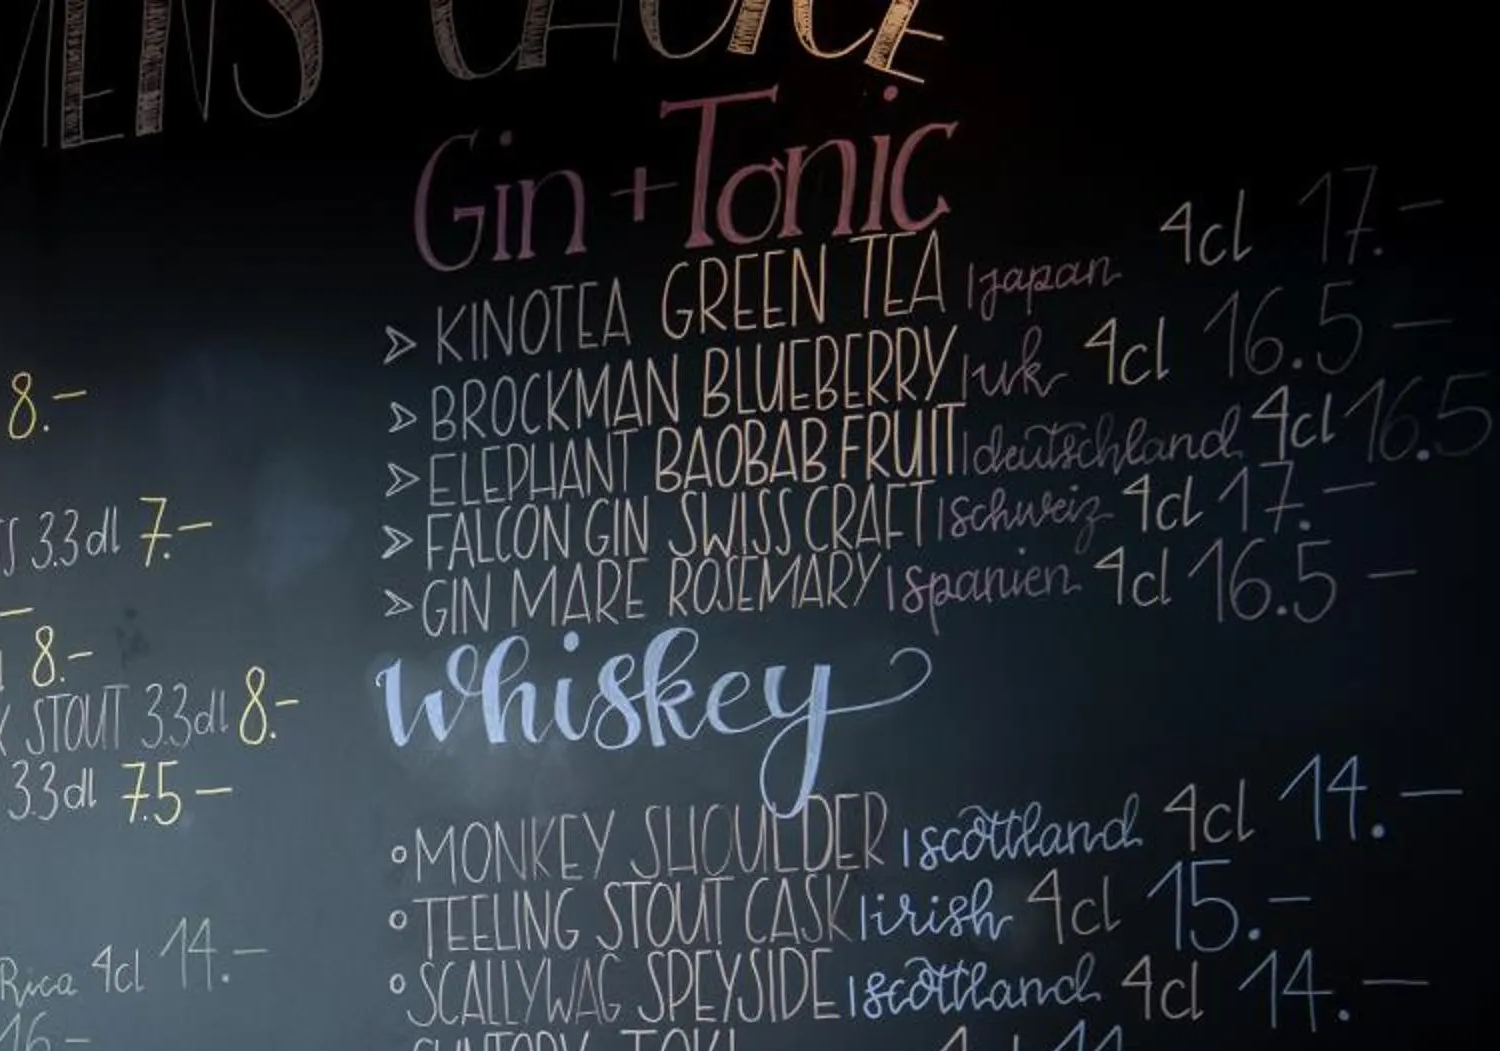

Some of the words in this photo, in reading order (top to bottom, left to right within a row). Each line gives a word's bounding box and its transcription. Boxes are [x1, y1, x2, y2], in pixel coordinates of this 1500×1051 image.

[413, 130, 588, 272] Gin
[660, 85, 959, 249] Tonic
[436, 276, 631, 365] KINOTEA
[662, 242, 826, 340] GREEN
[849, 229, 946, 319] TEA
[1160, 188, 1253, 266] 4cl
[430, 353, 680, 441] BROCKMAN
[702, 325, 958, 419] BLUEBERRY
[1084, 316, 1169, 385] 4cl
[429, 427, 639, 506] ELEPHANT
[655, 418, 827, 494] BAOBAB
[840, 402, 967, 480] FRUIT
[1251, 385, 1336, 460] 4cl
[426, 502, 570, 571] FALCON
[584, 494, 649, 558] GIN
[667, 487, 793, 558] SWISS
[804, 480, 936, 553] CRAFT
[1122, 473, 1204, 533] 4cl
[422, 570, 492, 638] GIN
[511, 556, 649, 629] MARE
[668, 550, 882, 618] ROSEMARY
[1093, 545, 1172, 606] 4cl
[25, 683, 130, 754] STOUT
[415, 809, 615, 885] MONKEY
[630, 791, 888, 878] SHOULDER
[1164, 777, 1256, 852] 4cl
[412, 887, 580, 959] TEELING
[596, 876, 735, 951] STOUT
[745, 873, 853, 944] CASK
[1026, 867, 1122, 945] 4cl
[91, 943, 145, 993] 4cl
[406, 953, 622, 1027] SCALLYWAG
[637, 947, 842, 1024] SPEYSIDE
[1121, 954, 1204, 1022] 4cl
